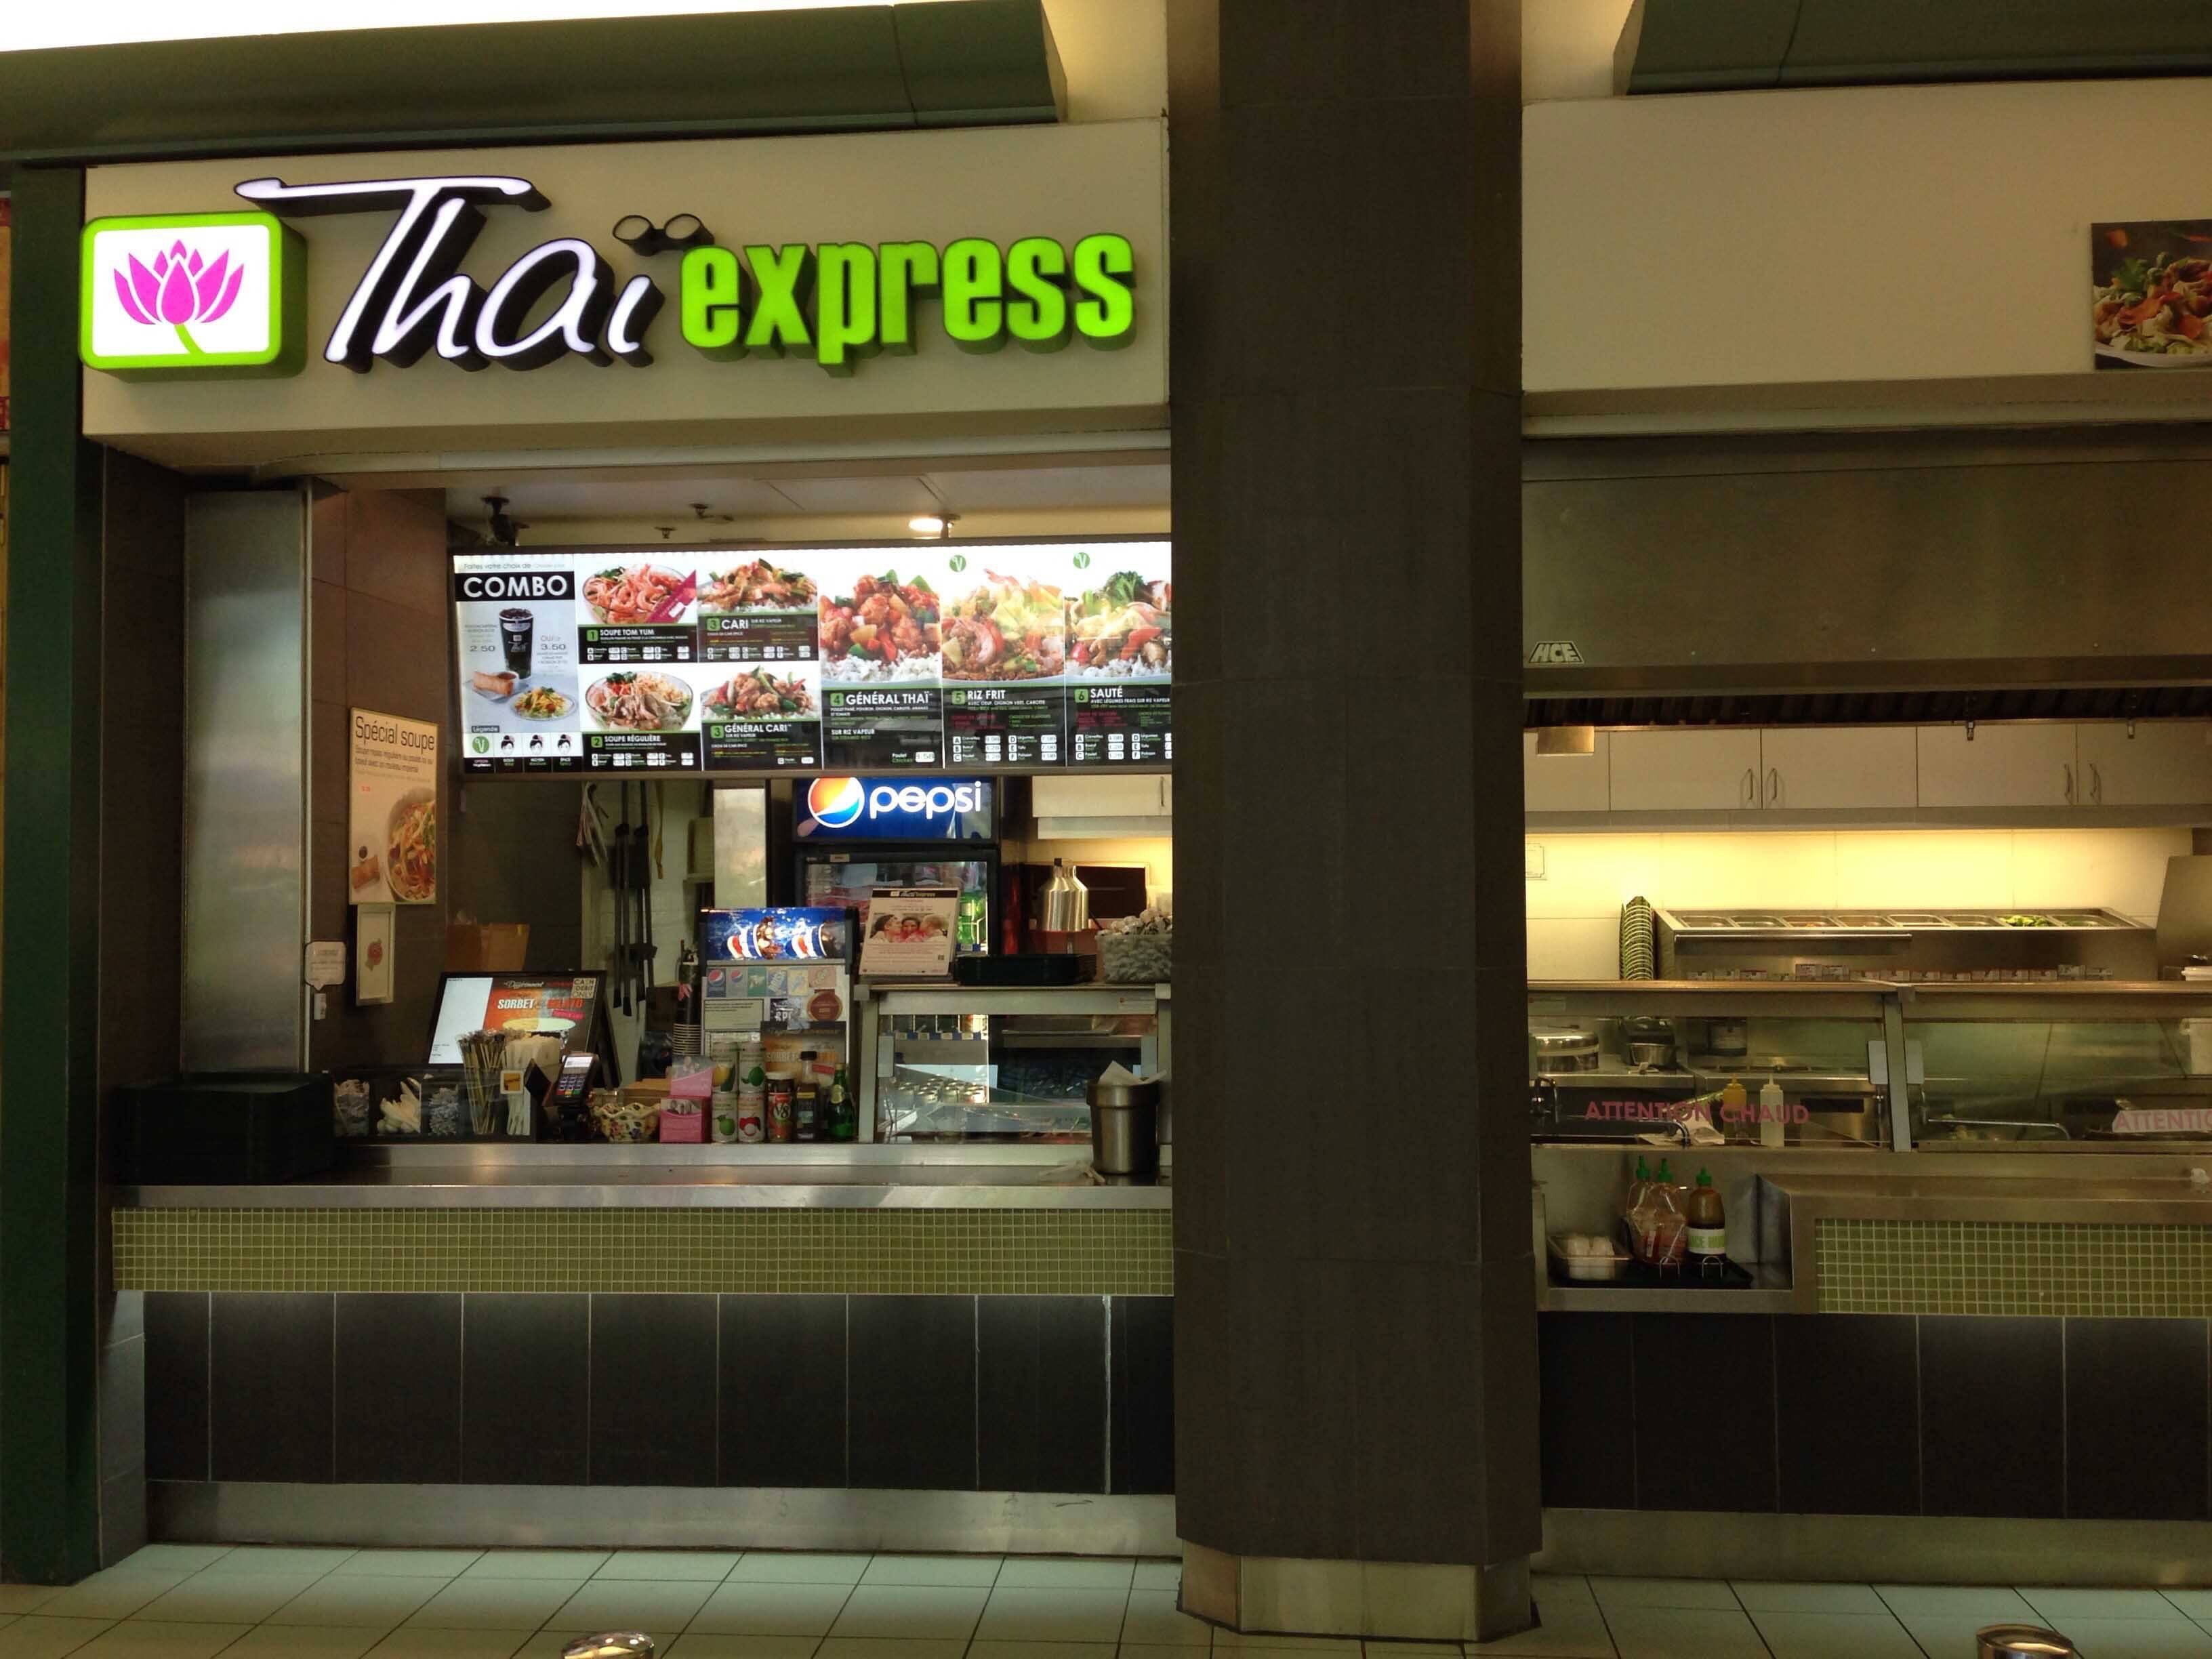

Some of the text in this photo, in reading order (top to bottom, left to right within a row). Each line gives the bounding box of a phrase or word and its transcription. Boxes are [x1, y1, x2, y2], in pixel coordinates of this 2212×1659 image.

[680, 232, 1134, 367] express
[464, 575, 568, 598] COMBO
[721, 619, 749, 630] CARI
[846, 691, 900, 705] GÉNÉRAL
[967, 690, 1006, 700] RIZ FRIT
[1090, 685, 1123, 698] SAUTÉ
[724, 722, 764, 733] GÉNÉRAL
[355, 716, 434, 754] Spécial soupe
[869, 781, 981, 819] pepsi
[497, 998, 535, 1009] SORBET
[775, 1105, 790, 1118] V8
[1584, 1101, 1811, 1125] ATTENTION CHAUD
